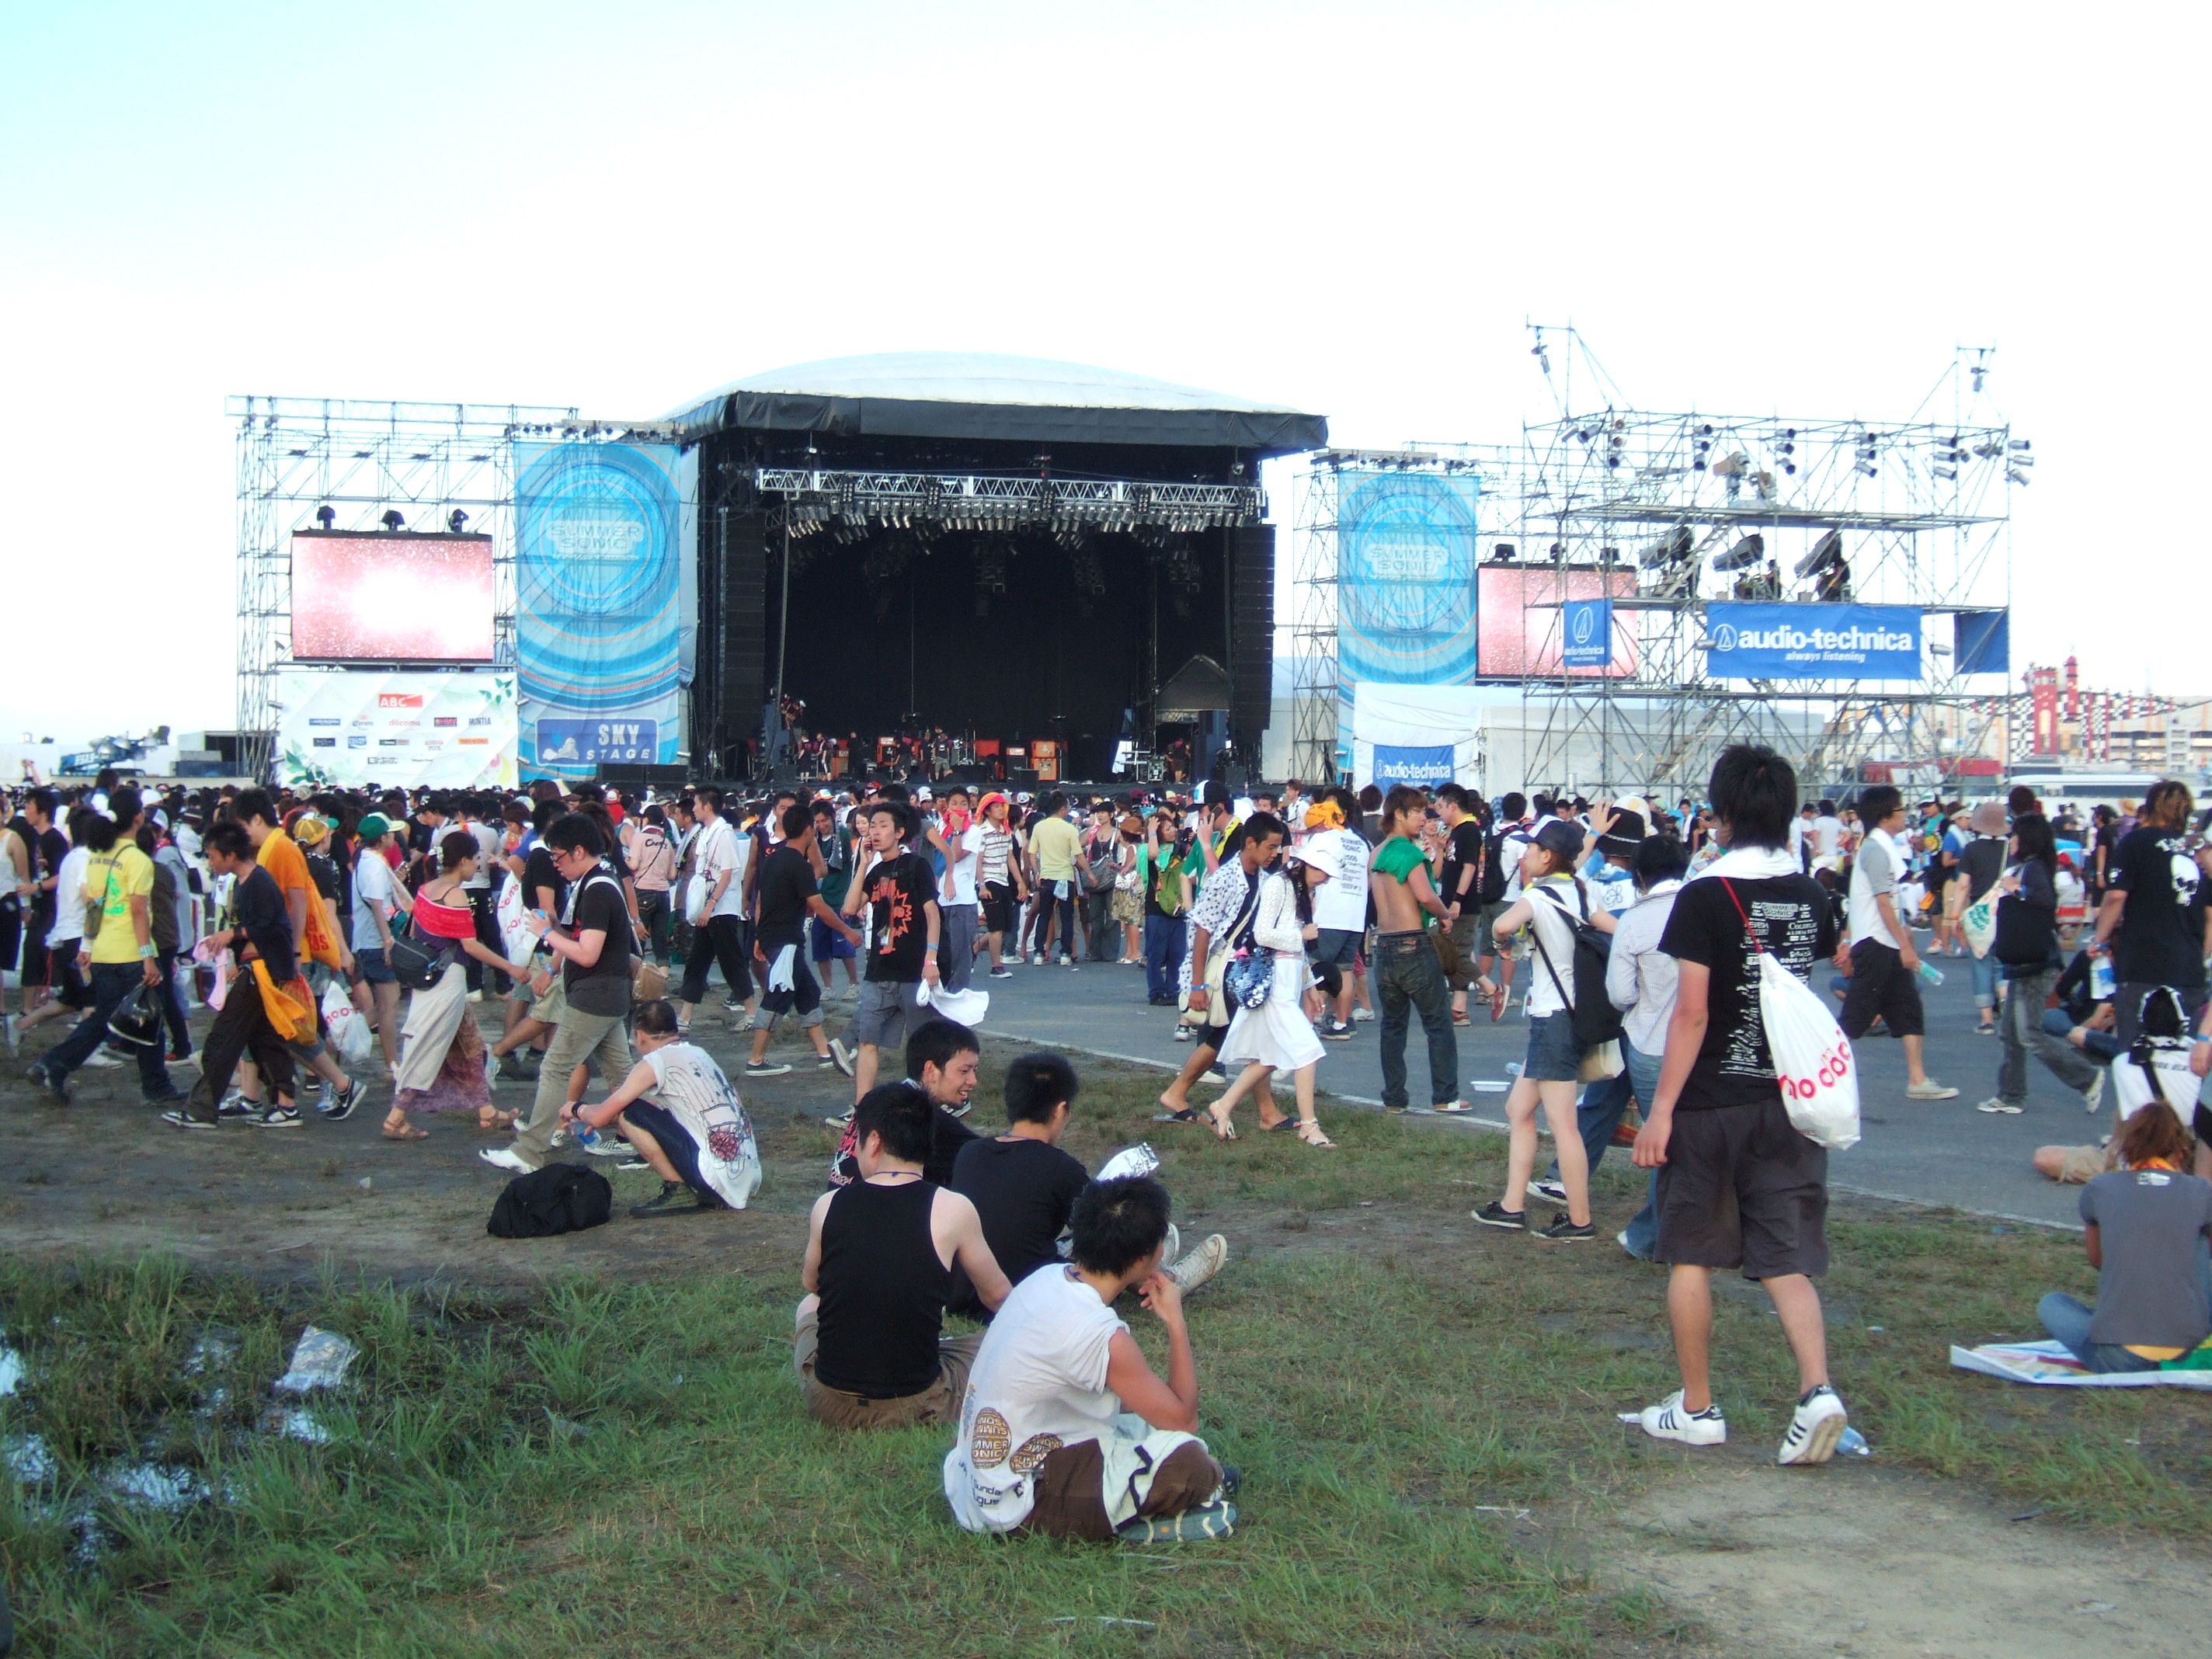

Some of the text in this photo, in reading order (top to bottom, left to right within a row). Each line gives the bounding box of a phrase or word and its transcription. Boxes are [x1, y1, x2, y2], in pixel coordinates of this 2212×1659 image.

[1738, 624, 1913, 651] audio-technica
[1785, 651, 1866, 663] always listening
[380, 697, 407, 707] ABC
[598, 724, 639, 746] SKY
[586, 749, 651, 760] STAGE
[1384, 761, 1451, 779] audio-technica
